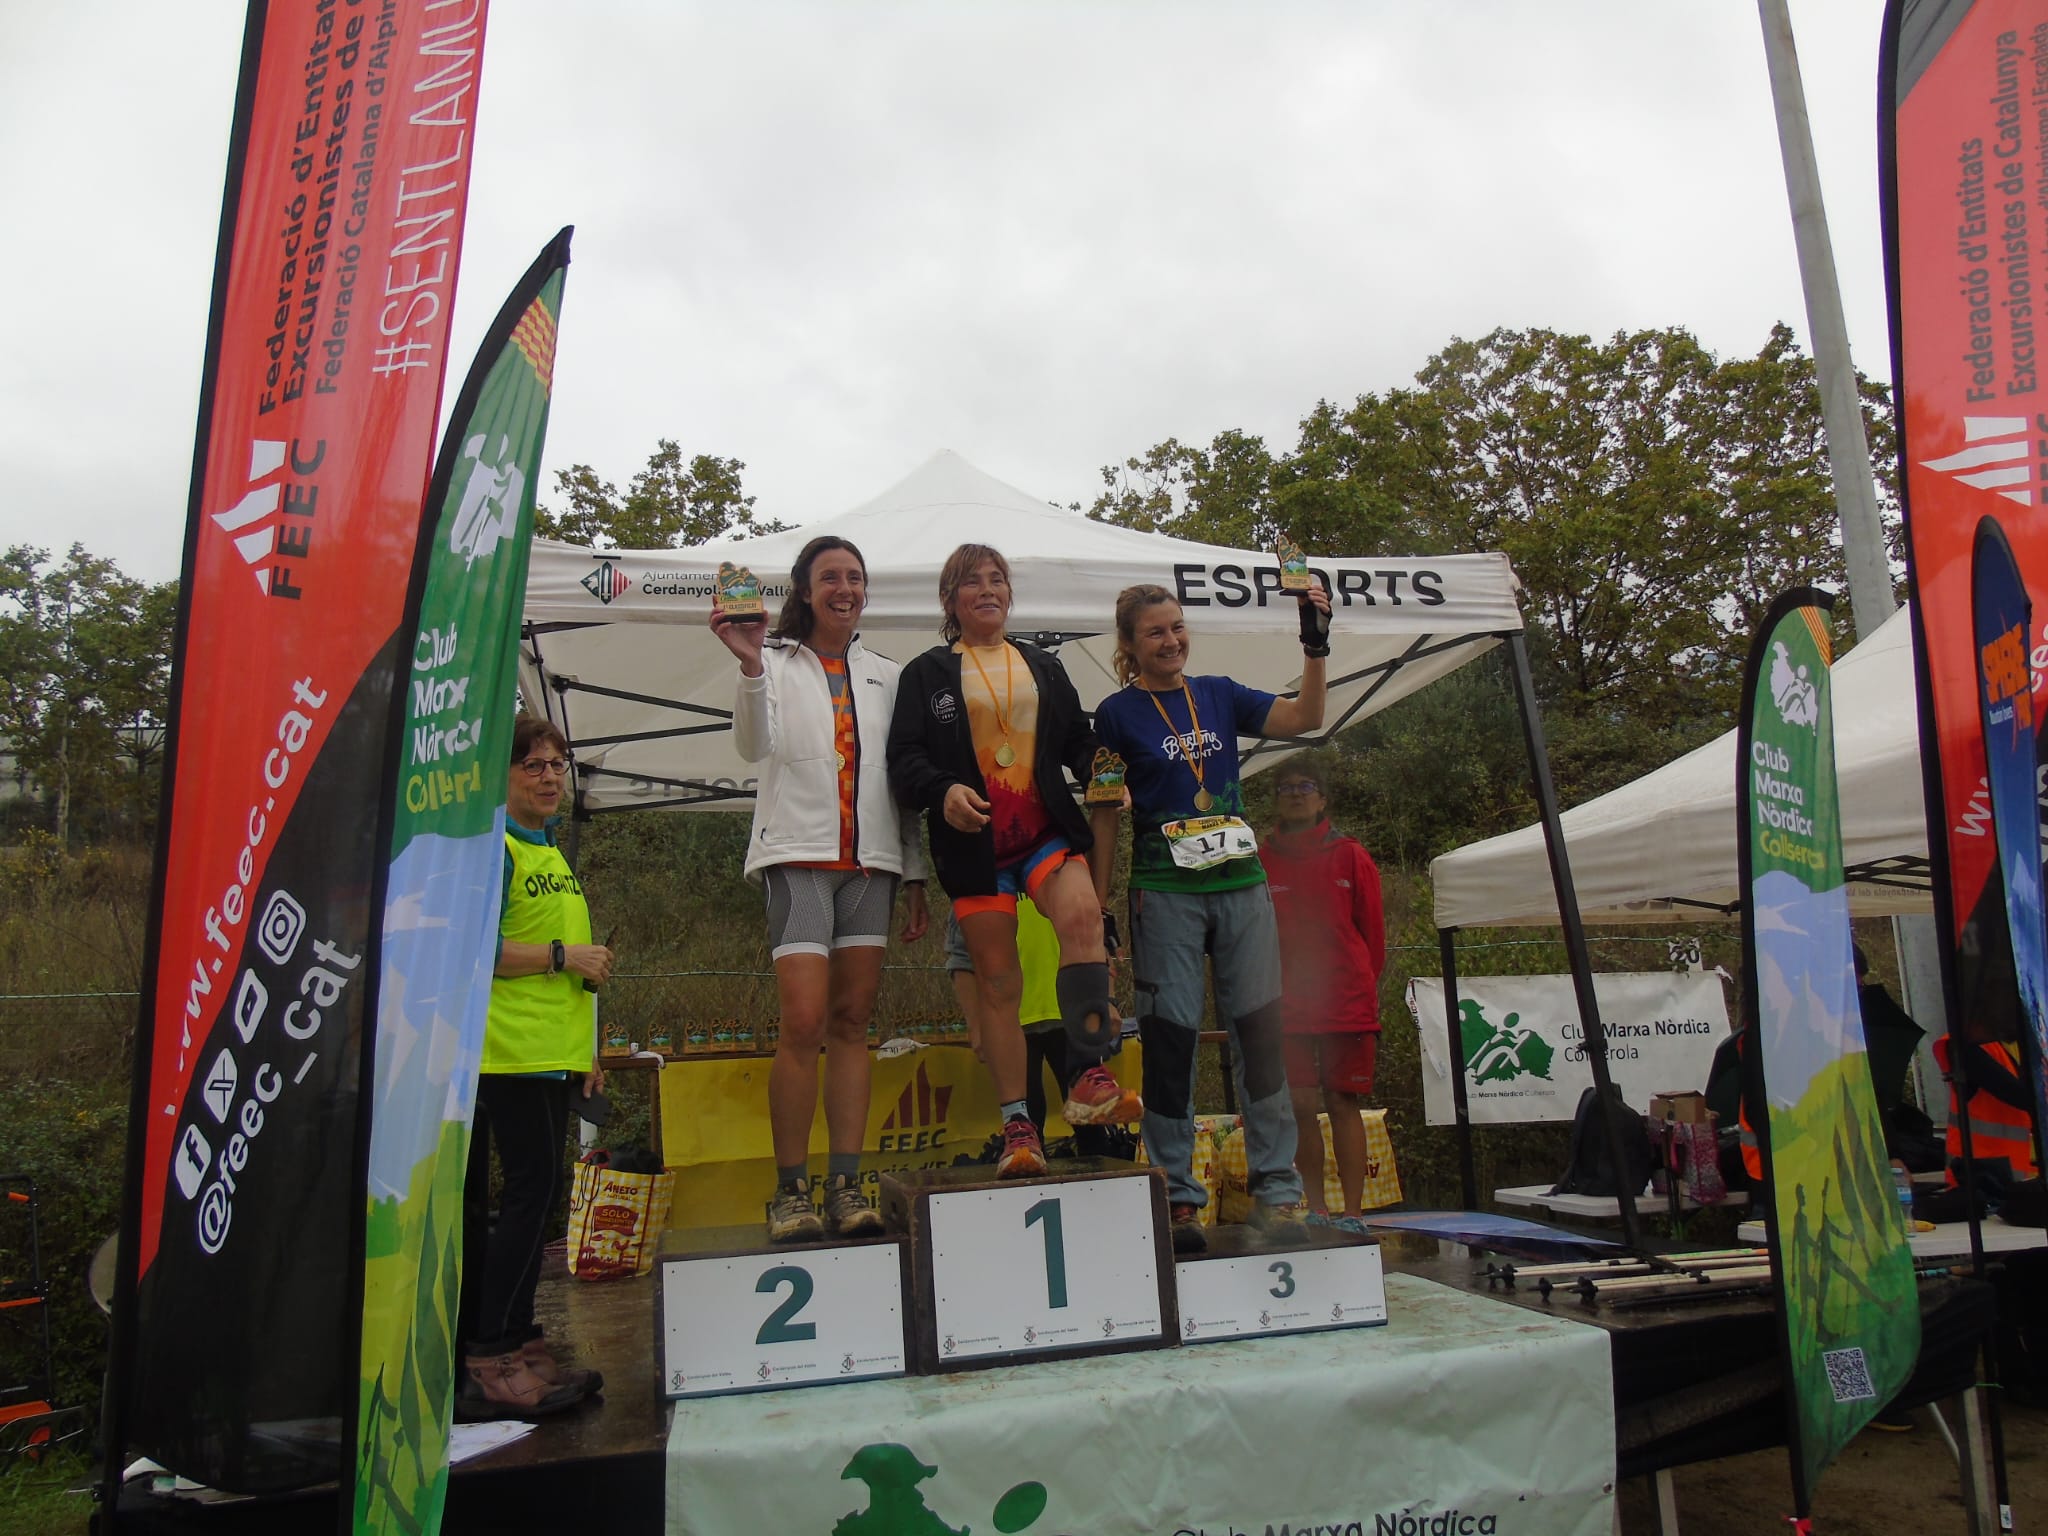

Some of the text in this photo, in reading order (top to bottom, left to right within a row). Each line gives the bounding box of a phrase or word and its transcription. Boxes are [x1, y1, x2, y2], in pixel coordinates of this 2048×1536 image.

[283, 79, 354, 404] Excursionistes
[336, 14, 364, 70] de
[1990, 30, 2037, 396] Excursionistes de Catalunya
[314, 245, 361, 394] Federació
[344, 104, 382, 238] Catalana
[1957, 137, 1996, 403] Federació d'Entitats
[259, 194, 307, 416] Federació
[271, 439, 326, 600] FEEC
[414, 622, 457, 671] Club
[1180, 749, 1213, 761] AUNT
[1752, 741, 1789, 773] Club
[1754, 769, 1803, 806] Marxa
[1196, 831, 1226, 854] 17
[165, 676, 329, 1114] w.feec.cat
[1561, 1019, 1711, 1040] Clu Marxa Nòrdica
[198, 938, 363, 1254] @feec_cat
[602, 1208, 630, 1219] SOLO
[604, 1181, 639, 1196] ANETO
[1024, 1198, 1068, 1309] 1
[1268, 1260, 1296, 1299] 3
[755, 1265, 817, 1345] 2
[1374, 1508, 1497, 1536] Nòrdica
